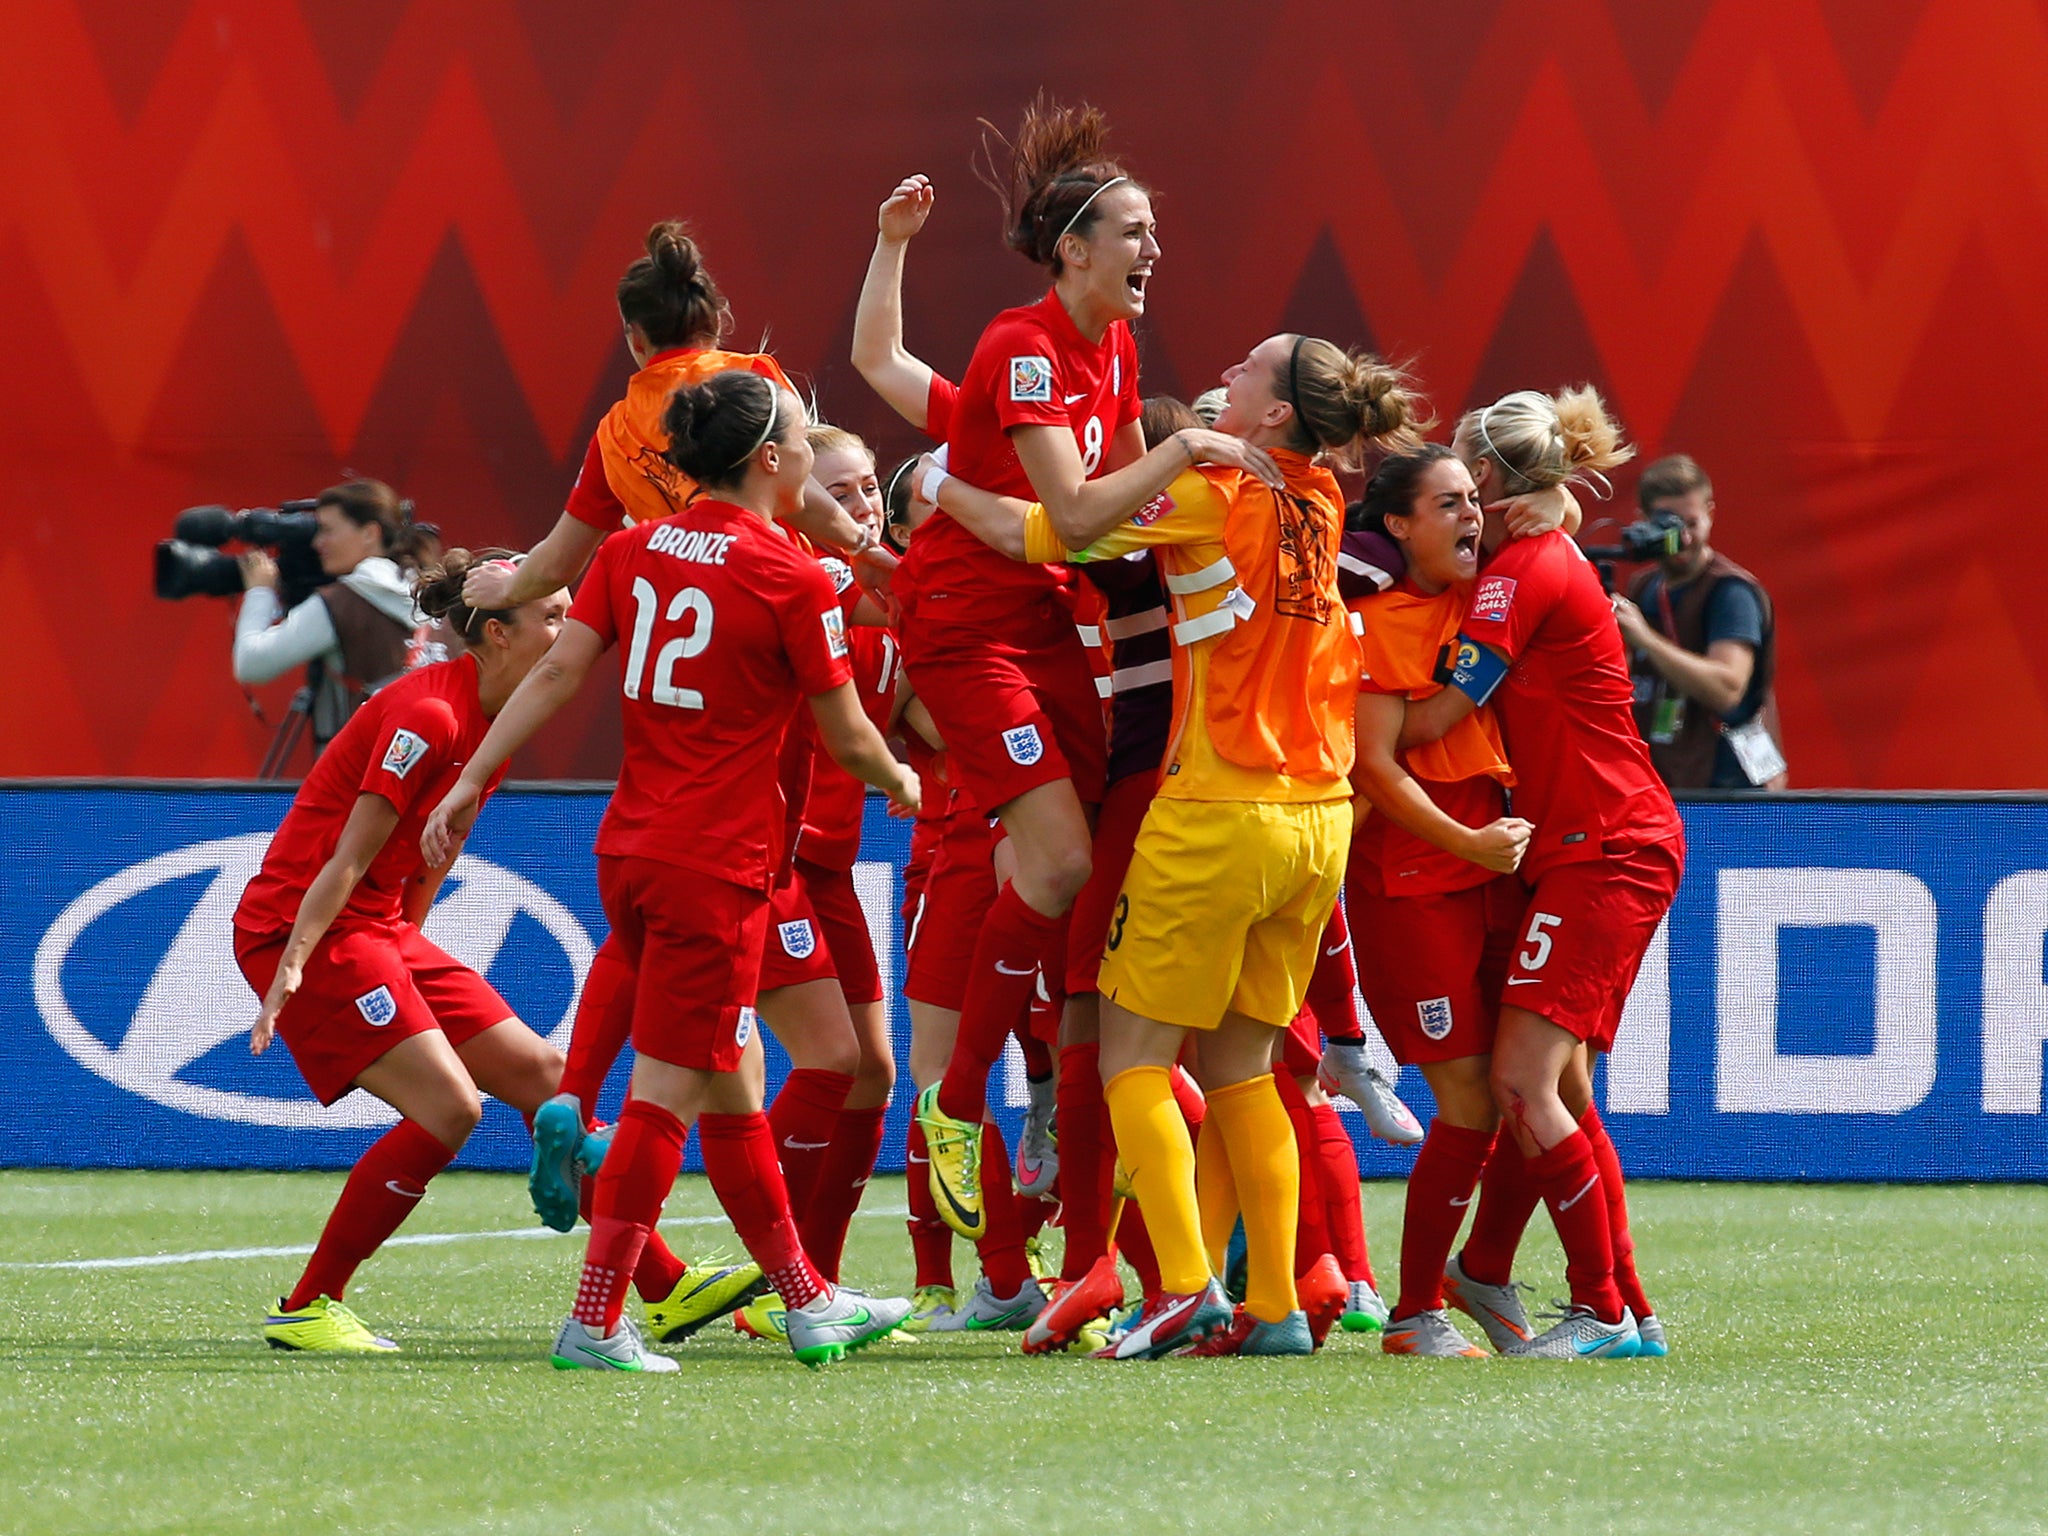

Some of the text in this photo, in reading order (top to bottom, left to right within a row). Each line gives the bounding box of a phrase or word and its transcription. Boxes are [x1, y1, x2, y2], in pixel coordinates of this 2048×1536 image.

[1083, 415, 1103, 475] 8
[646, 523, 738, 566] BRONZE
[1475, 599, 1507, 614] GOALS
[1477, 590, 1506, 603] YOUR
[1479, 581, 1502, 592] LIVE
[623, 575, 714, 710] 12
[877, 633, 902, 693] 1
[1519, 912, 1563, 972] 5
